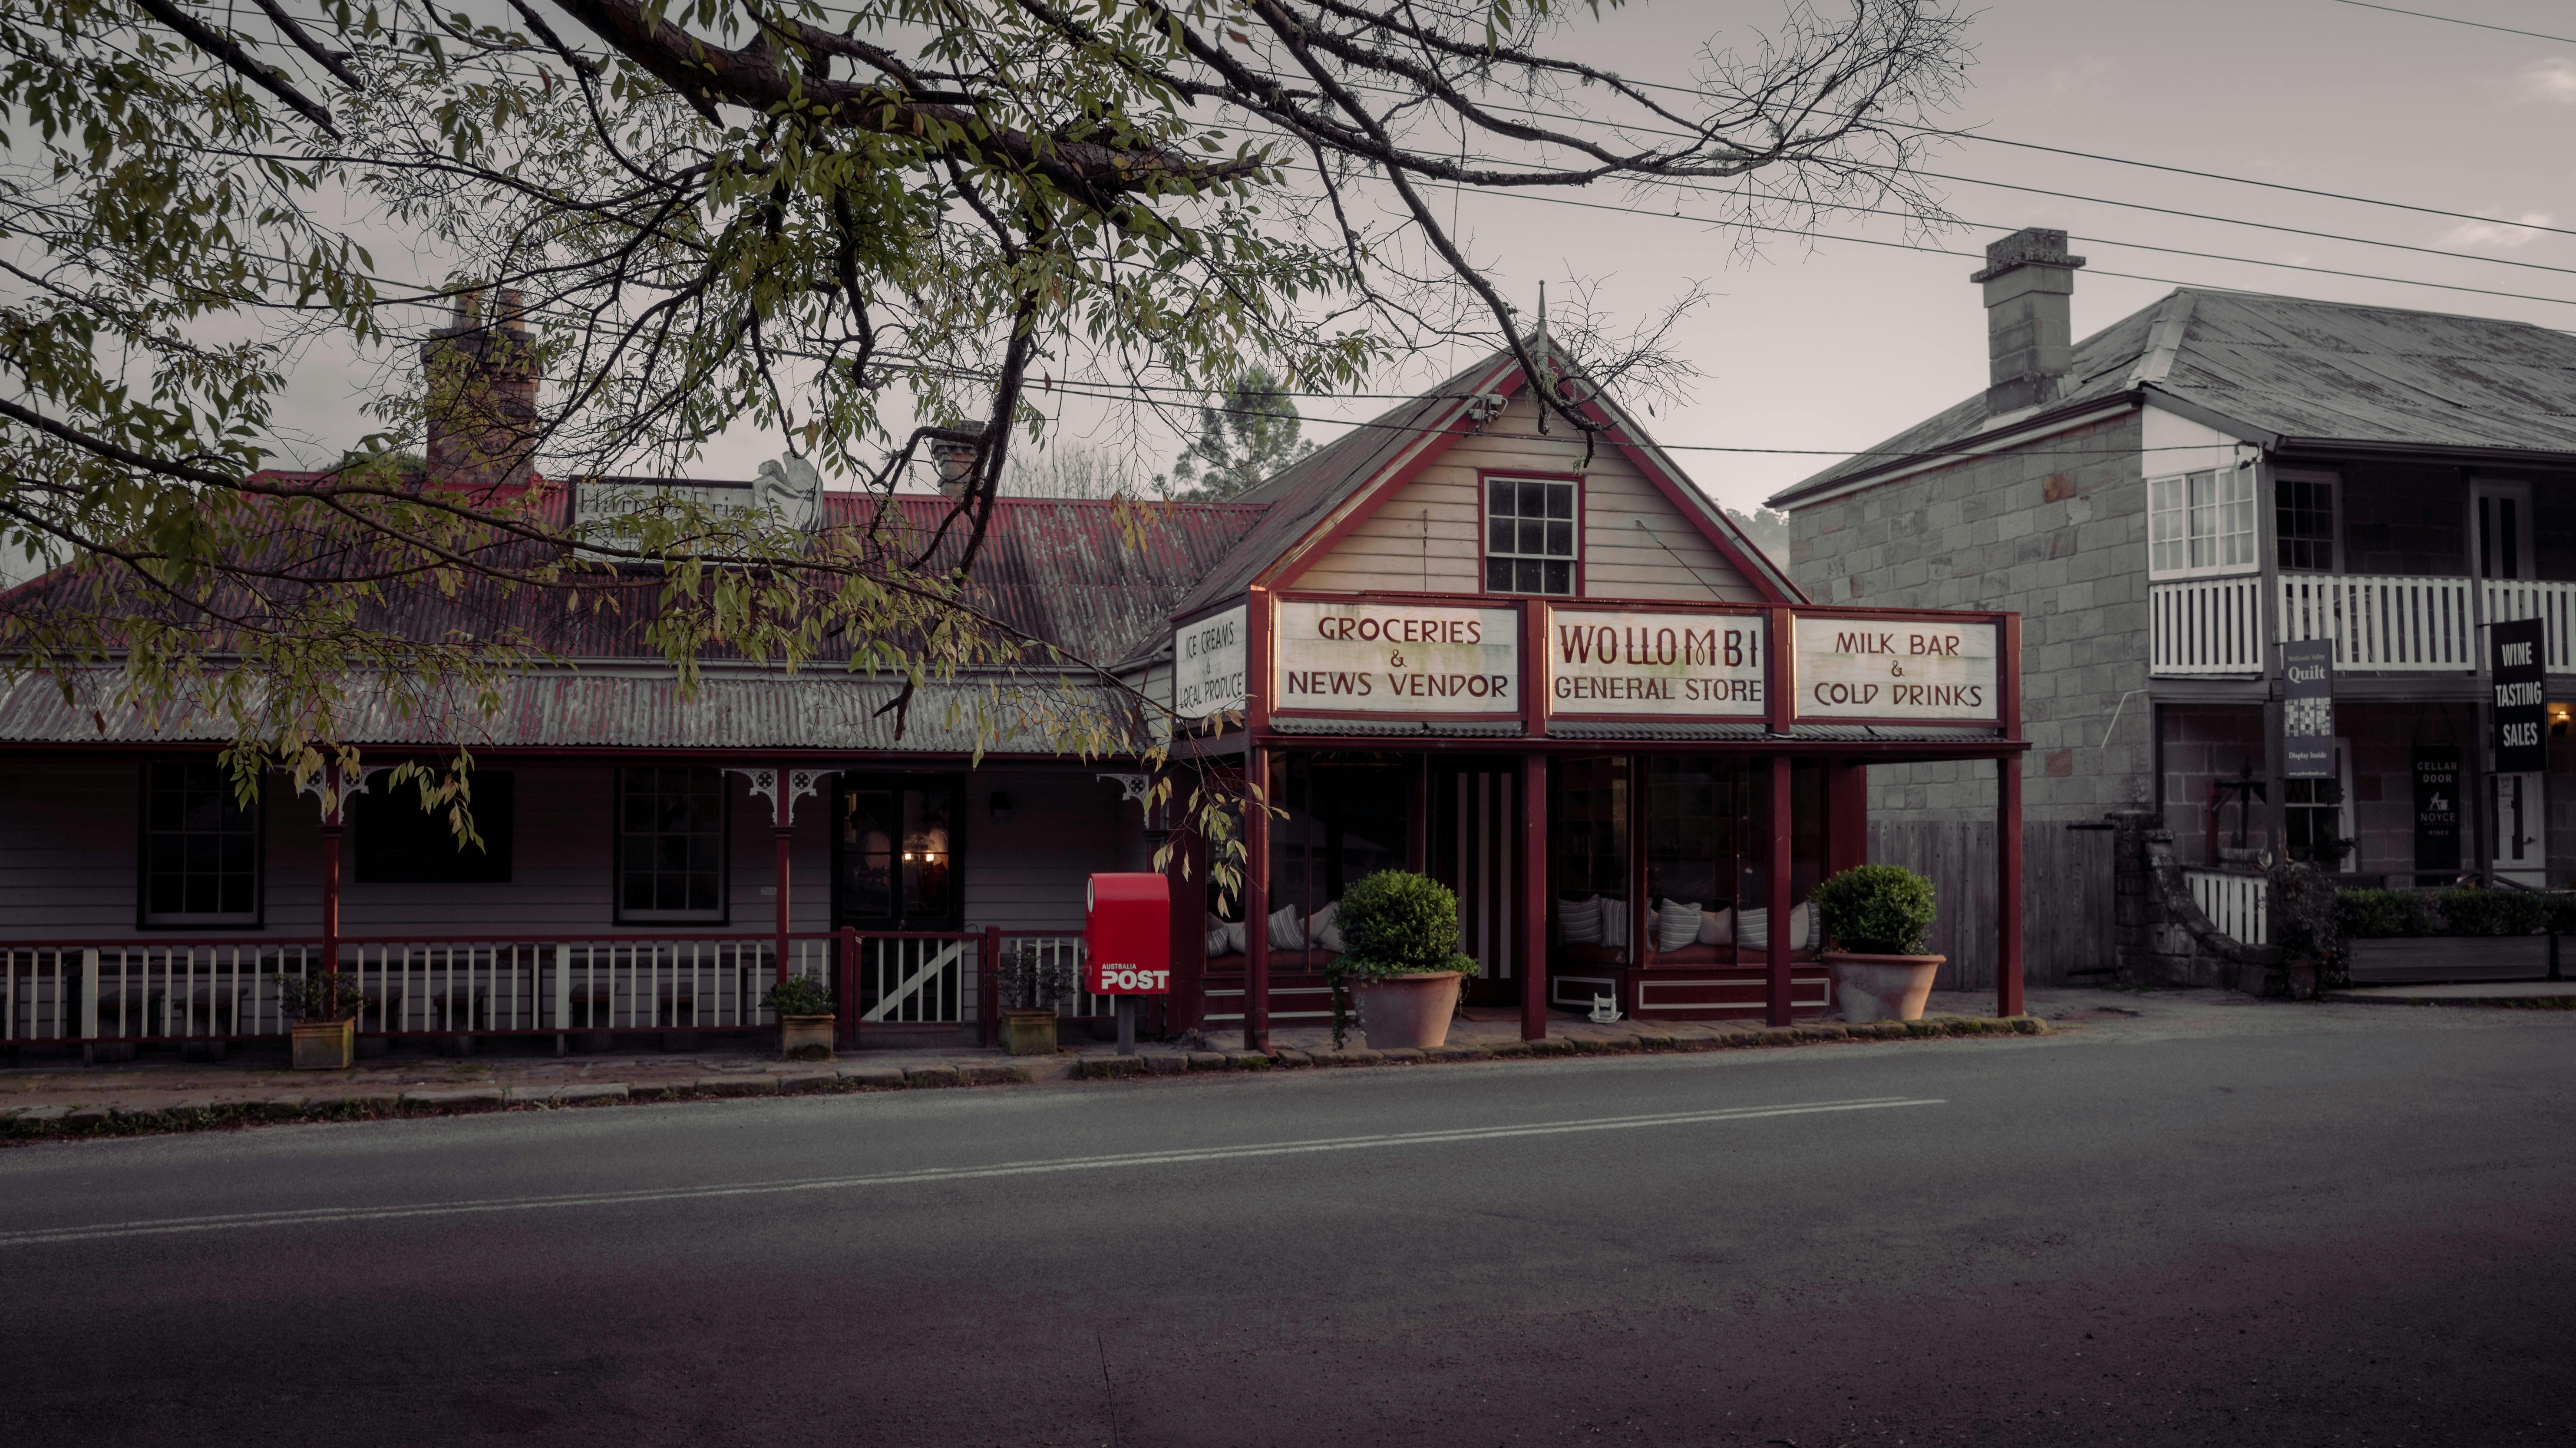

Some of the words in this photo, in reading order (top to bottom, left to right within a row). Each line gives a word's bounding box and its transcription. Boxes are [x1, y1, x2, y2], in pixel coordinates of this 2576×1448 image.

[1186, 635, 1196, 659] ICE
[1201, 621, 1234, 654] CREAMS
[1318, 616, 1481, 645] GROCERIES
[1559, 625, 1758, 668] WOLLOMBI
[1835, 632, 1895, 654] MILK
[1910, 635, 1959, 656] BAR
[2502, 642, 2533, 667] WINE
[1207, 657, 1211, 675] &
[1390, 649, 1407, 667] &
[1891, 660, 1905, 677] &
[2311, 653, 2325, 661] Valley
[1288, 671, 1371, 696] NEWS
[1388, 673, 1508, 697] VENDOR
[2288, 665, 2325, 684] Quilt
[1180, 684, 1202, 709] LOCAL
[1205, 673, 1242, 703] PRODUCE
[1555, 676, 1675, 700] GENERAL
[1685, 679, 1762, 702] STORE
[1814, 683, 1878, 706] COLD
[1893, 684, 1982, 707] DRINKS
[2495, 681, 2542, 708] TASTING
[2503, 722, 2538, 747] SALES
[2289, 752, 2308, 761] Display
[2417, 762, 2457, 771] CELLAR
[2423, 774, 2452, 783] DOOR
[2421, 813, 2455, 822] NOYCE
[1101, 970, 1169, 990] POST
